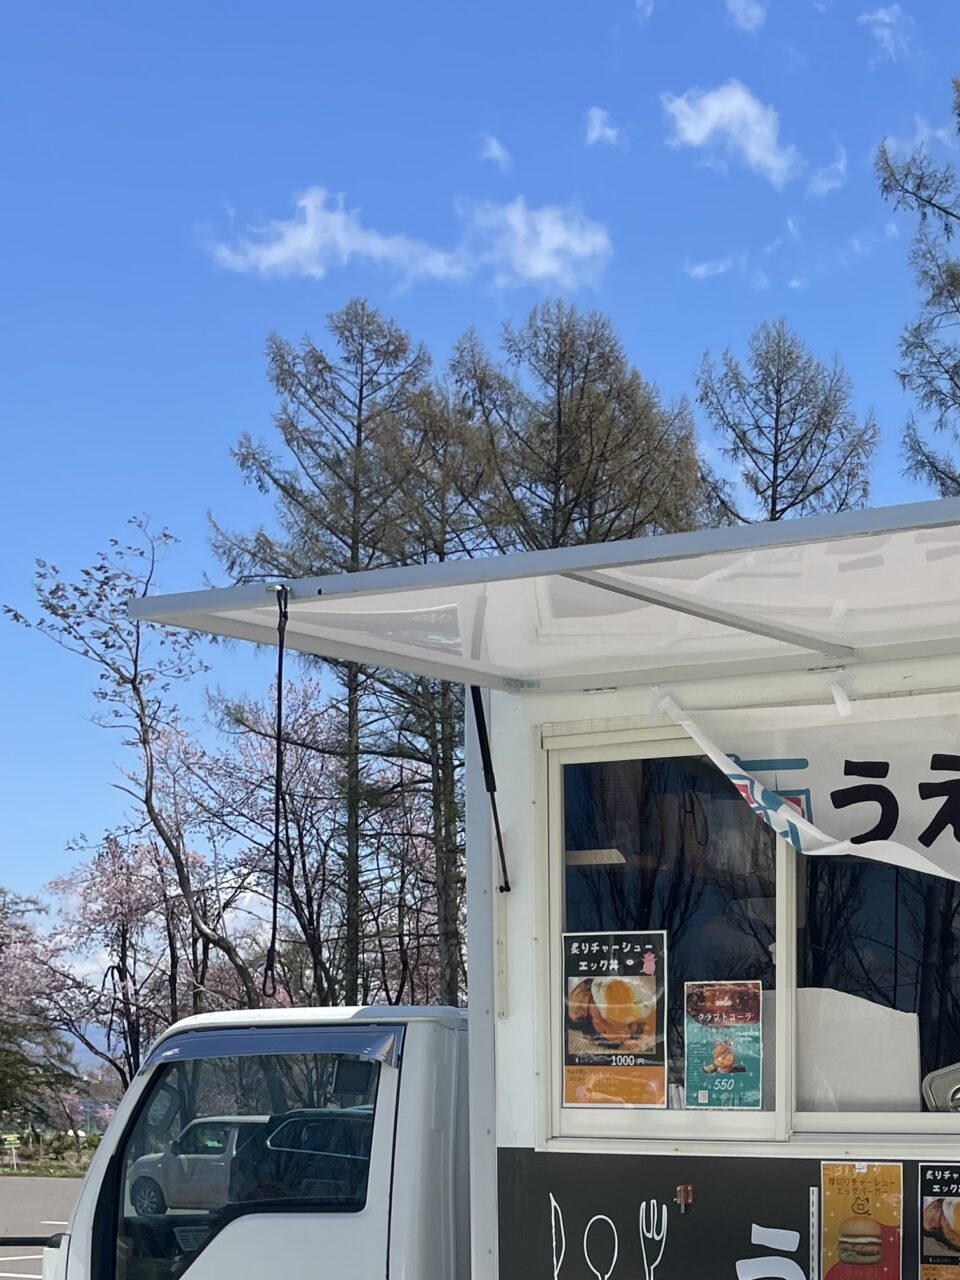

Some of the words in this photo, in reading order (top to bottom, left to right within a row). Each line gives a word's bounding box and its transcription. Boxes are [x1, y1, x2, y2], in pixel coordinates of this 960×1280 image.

[570, 942, 653, 954] 炙りチャーシュー
[579, 959, 619, 971] エッグ丼
[697, 1012, 753, 1021] クラフトコーラ
[611, 1055, 635, 1066] 1000
[713, 1079, 735, 1090] 550
